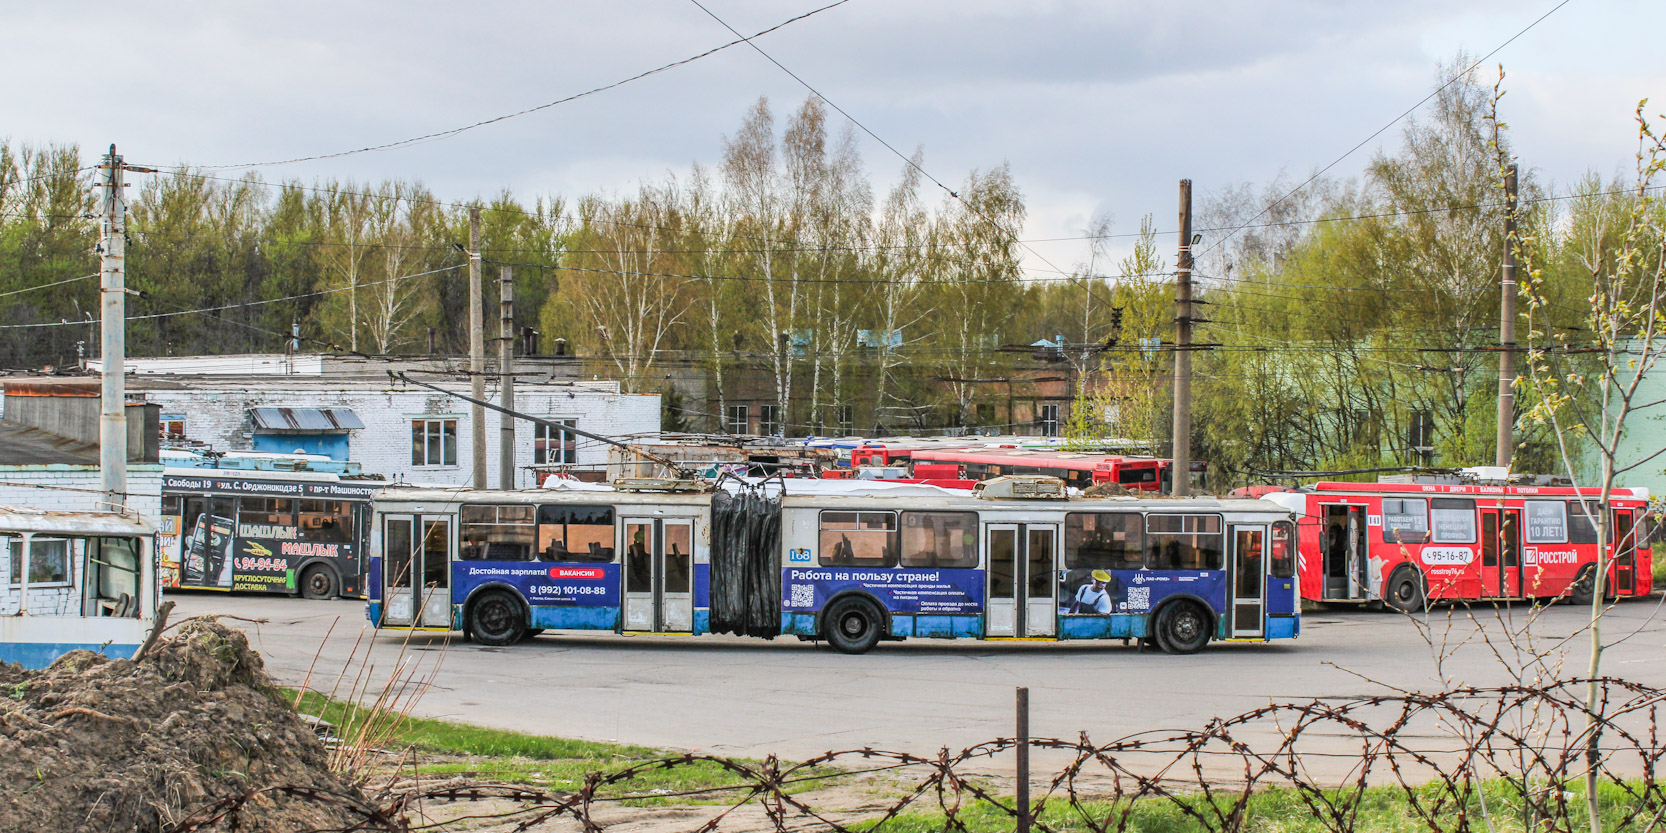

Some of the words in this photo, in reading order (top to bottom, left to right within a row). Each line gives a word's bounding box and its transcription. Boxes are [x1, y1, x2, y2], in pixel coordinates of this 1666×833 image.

[168, 478, 201, 489] Свободы
[203, 480, 212, 488] 19
[221, 482, 232, 490] ул.
[233, 481, 241, 490] С.
[242, 481, 297, 493] Орджоникидзе
[298, 484, 303, 493] 5
[313, 485, 329, 494] пр-т
[330, 485, 375, 496] Машиностр
[1369, 516, 1380, 524] 141
[1530, 517, 1561, 525] ГАРАНТИЮ
[239, 524, 297, 539] ШАШЛЫК
[1530, 526, 1540, 537] 10
[1542, 526, 1563, 537] ЛЕТ!
[281, 542, 339, 557] МАШЛЫК
[791, 549, 810, 561] 168
[1432, 551, 1468, 560] 95-16-87
[1538, 549, 1578, 563] РОССТРОЙ
[241, 557, 287, 571] 94-94-54
[469, 567, 510, 576] Достойная
[510, 568, 547, 577] зарплата!
[559, 569, 595, 577] ВАКАНСИИ
[791, 570, 832, 580] Работа
[835, 573, 850, 581] на
[852, 572, 894, 583] пользу
[896, 571, 940, 583] стране!
[234, 583, 267, 591] ДОСТАВКА
[529, 585, 537, 593] 8
[538, 585, 562, 595] (992)
[563, 586, 606, 595] 101-08-88
